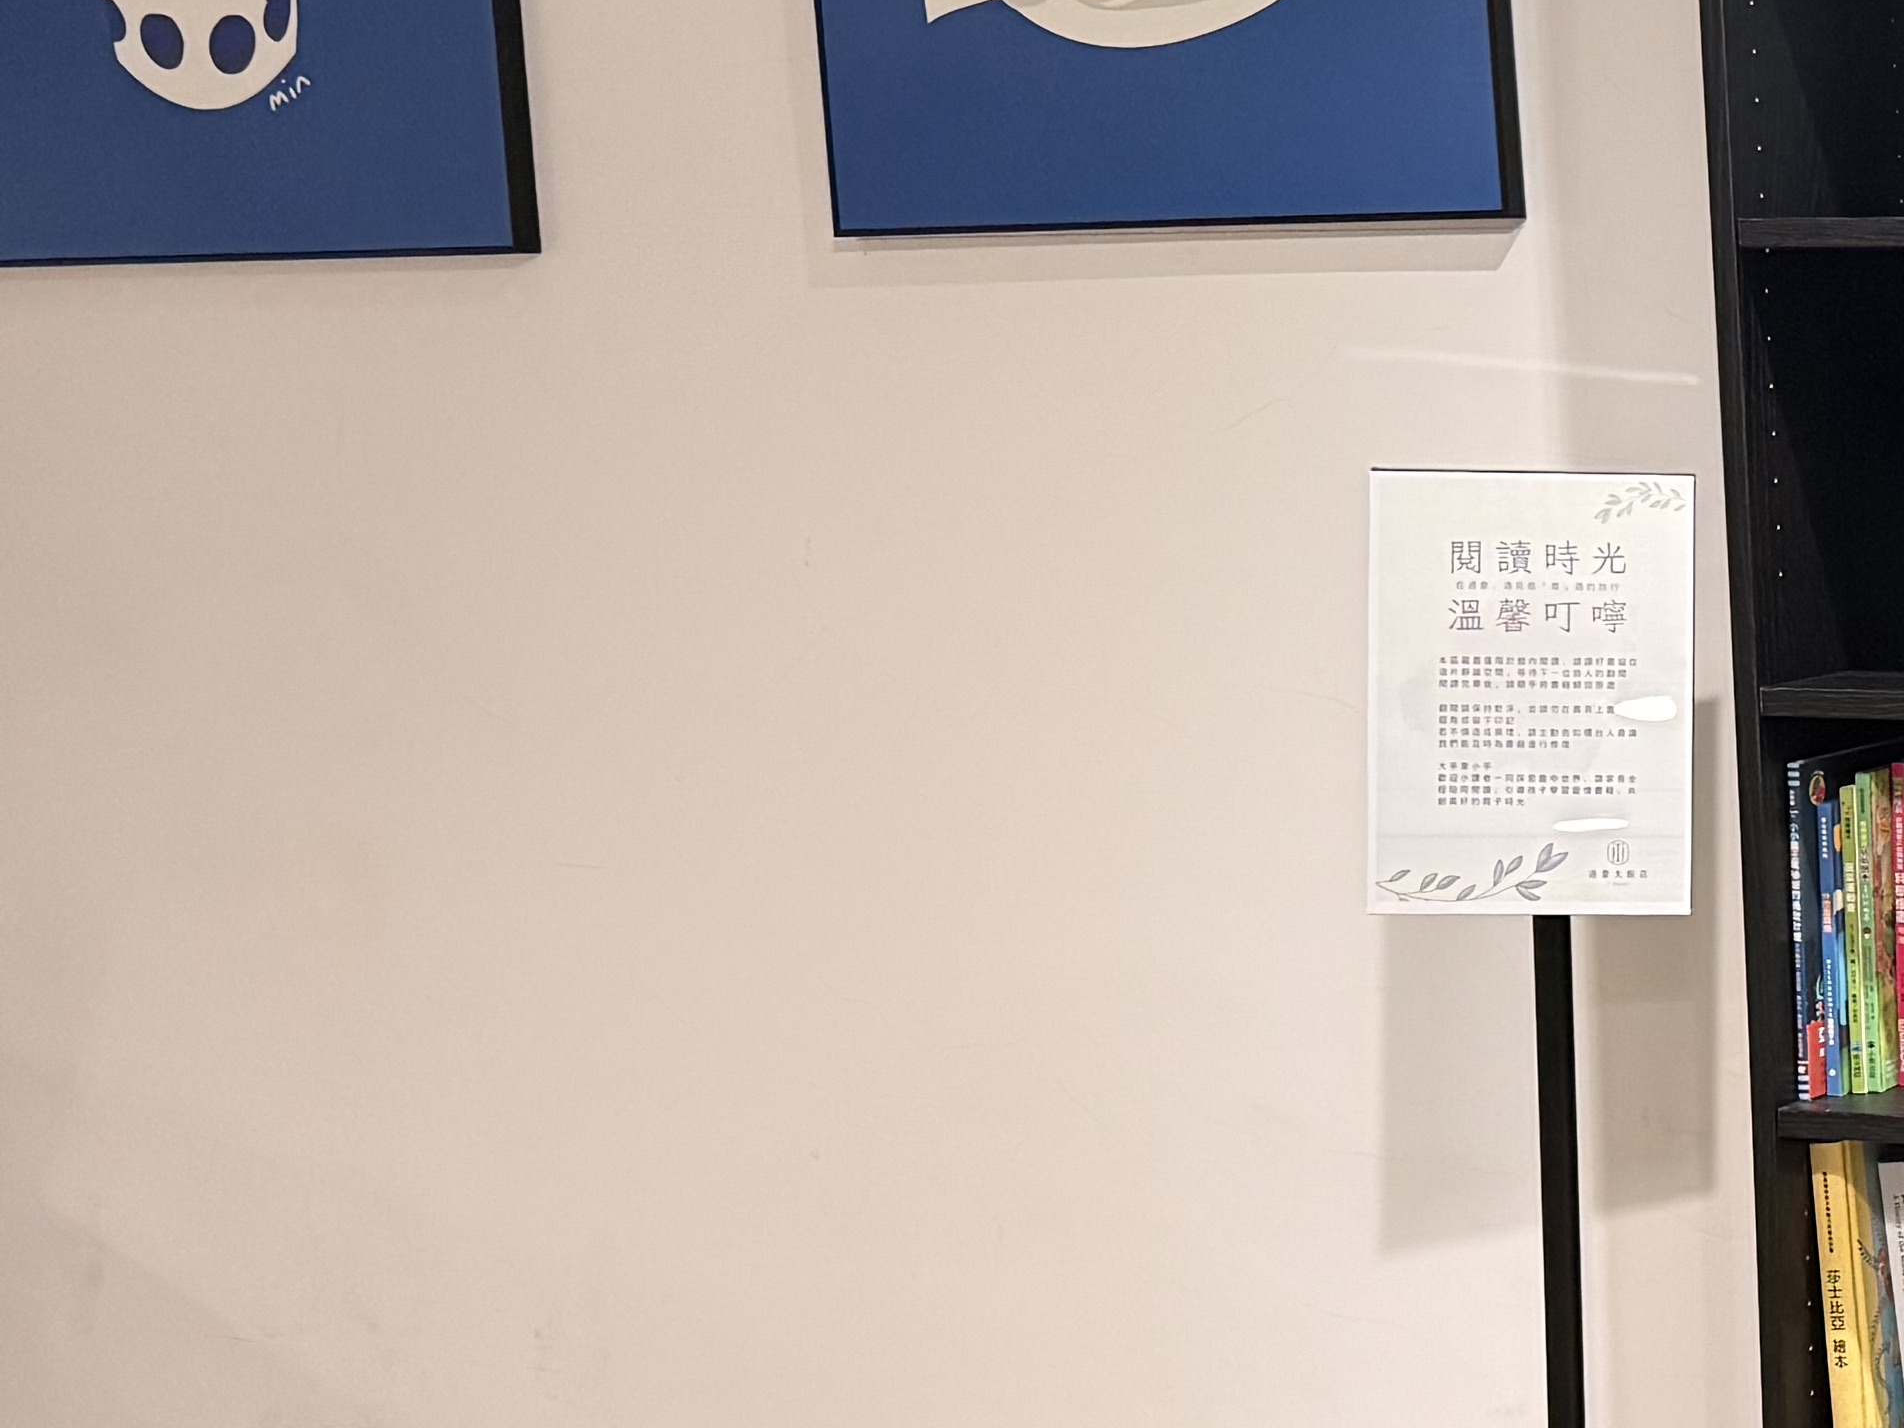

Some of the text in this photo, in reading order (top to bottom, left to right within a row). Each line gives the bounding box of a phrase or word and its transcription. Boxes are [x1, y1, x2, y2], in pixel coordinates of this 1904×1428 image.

[269, 74, 311, 111] min
[1450, 540, 1627, 575] 閱讀時光
[1448, 599, 1627, 633] 溫馨叮嚀
